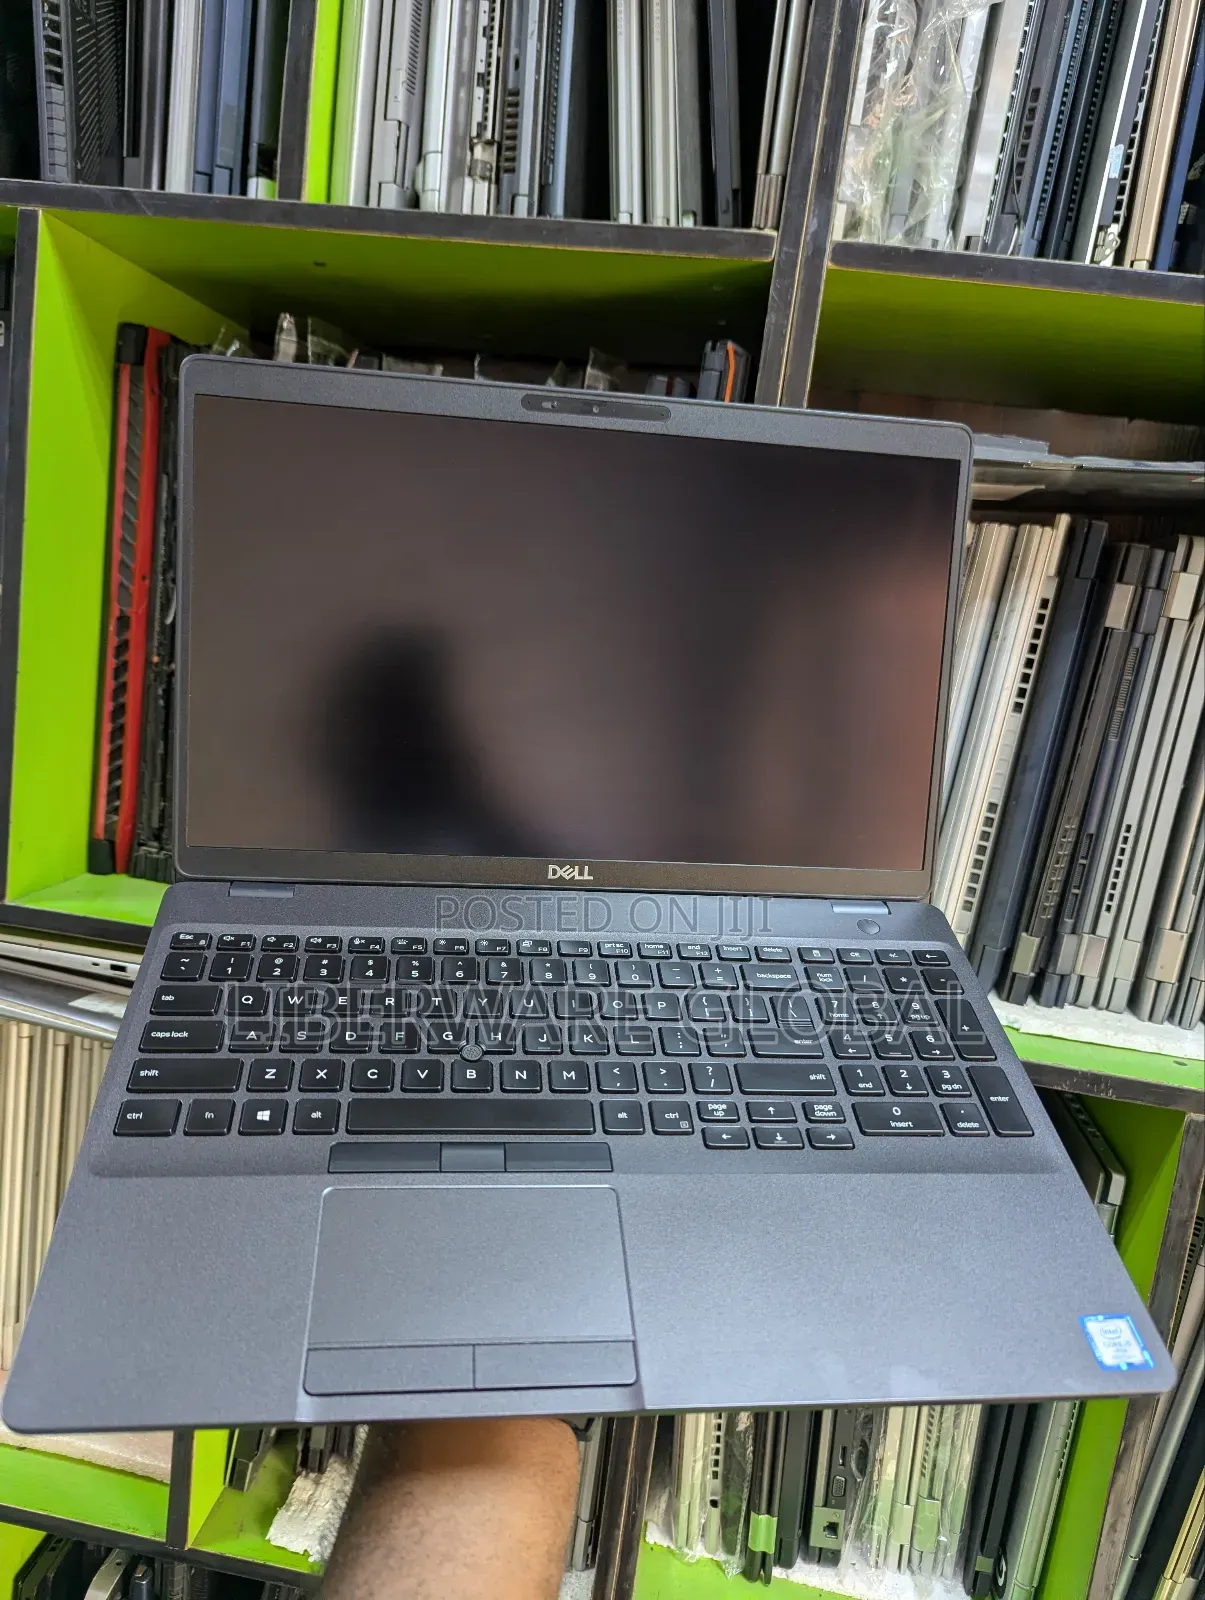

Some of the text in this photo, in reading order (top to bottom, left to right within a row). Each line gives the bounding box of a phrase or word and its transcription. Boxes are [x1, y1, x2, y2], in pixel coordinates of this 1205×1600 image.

[547, 864, 594, 880] DELL
[242, 995, 253, 1005] Q
[288, 996, 304, 1004] W
[338, 997, 347, 1005] E
[385, 998, 395, 1006] R
[432, 998, 442, 1006] T
[478, 998, 488, 1006] Y
[524, 999, 533, 1007] U
[612, 1001, 623, 1009] O
[657, 1001, 666, 1009] P
[831, 1001, 838, 1009] 7
[171, 1030, 188, 1038] lock
[246, 1031, 257, 1040] A
[297, 1031, 306, 1040] S
[346, 1032, 357, 1040] D
[395, 1032, 404, 1041] F
[442, 1031, 453, 1040] G
[491, 1032, 502, 1040] H
[538, 1034, 547, 1043] J
[584, 1034, 593, 1043] K
[631, 1035, 640, 1044] L
[265, 1069, 276, 1079] Z
[316, 1069, 327, 1079] X
[367, 1069, 378, 1079] C
[417, 1069, 429, 1079] V
[467, 1070, 477, 1079] B
[516, 1070, 527, 1079] N
[563, 1071, 576, 1080] M
[857, 1069, 863, 1077] 1
[900, 1070, 908, 1078] 2
[942, 1070, 951, 1078] 3
[708, 1104, 727, 1112] page
[892, 1107, 901, 1115] 0
[311, 1111, 322, 1119] alt
